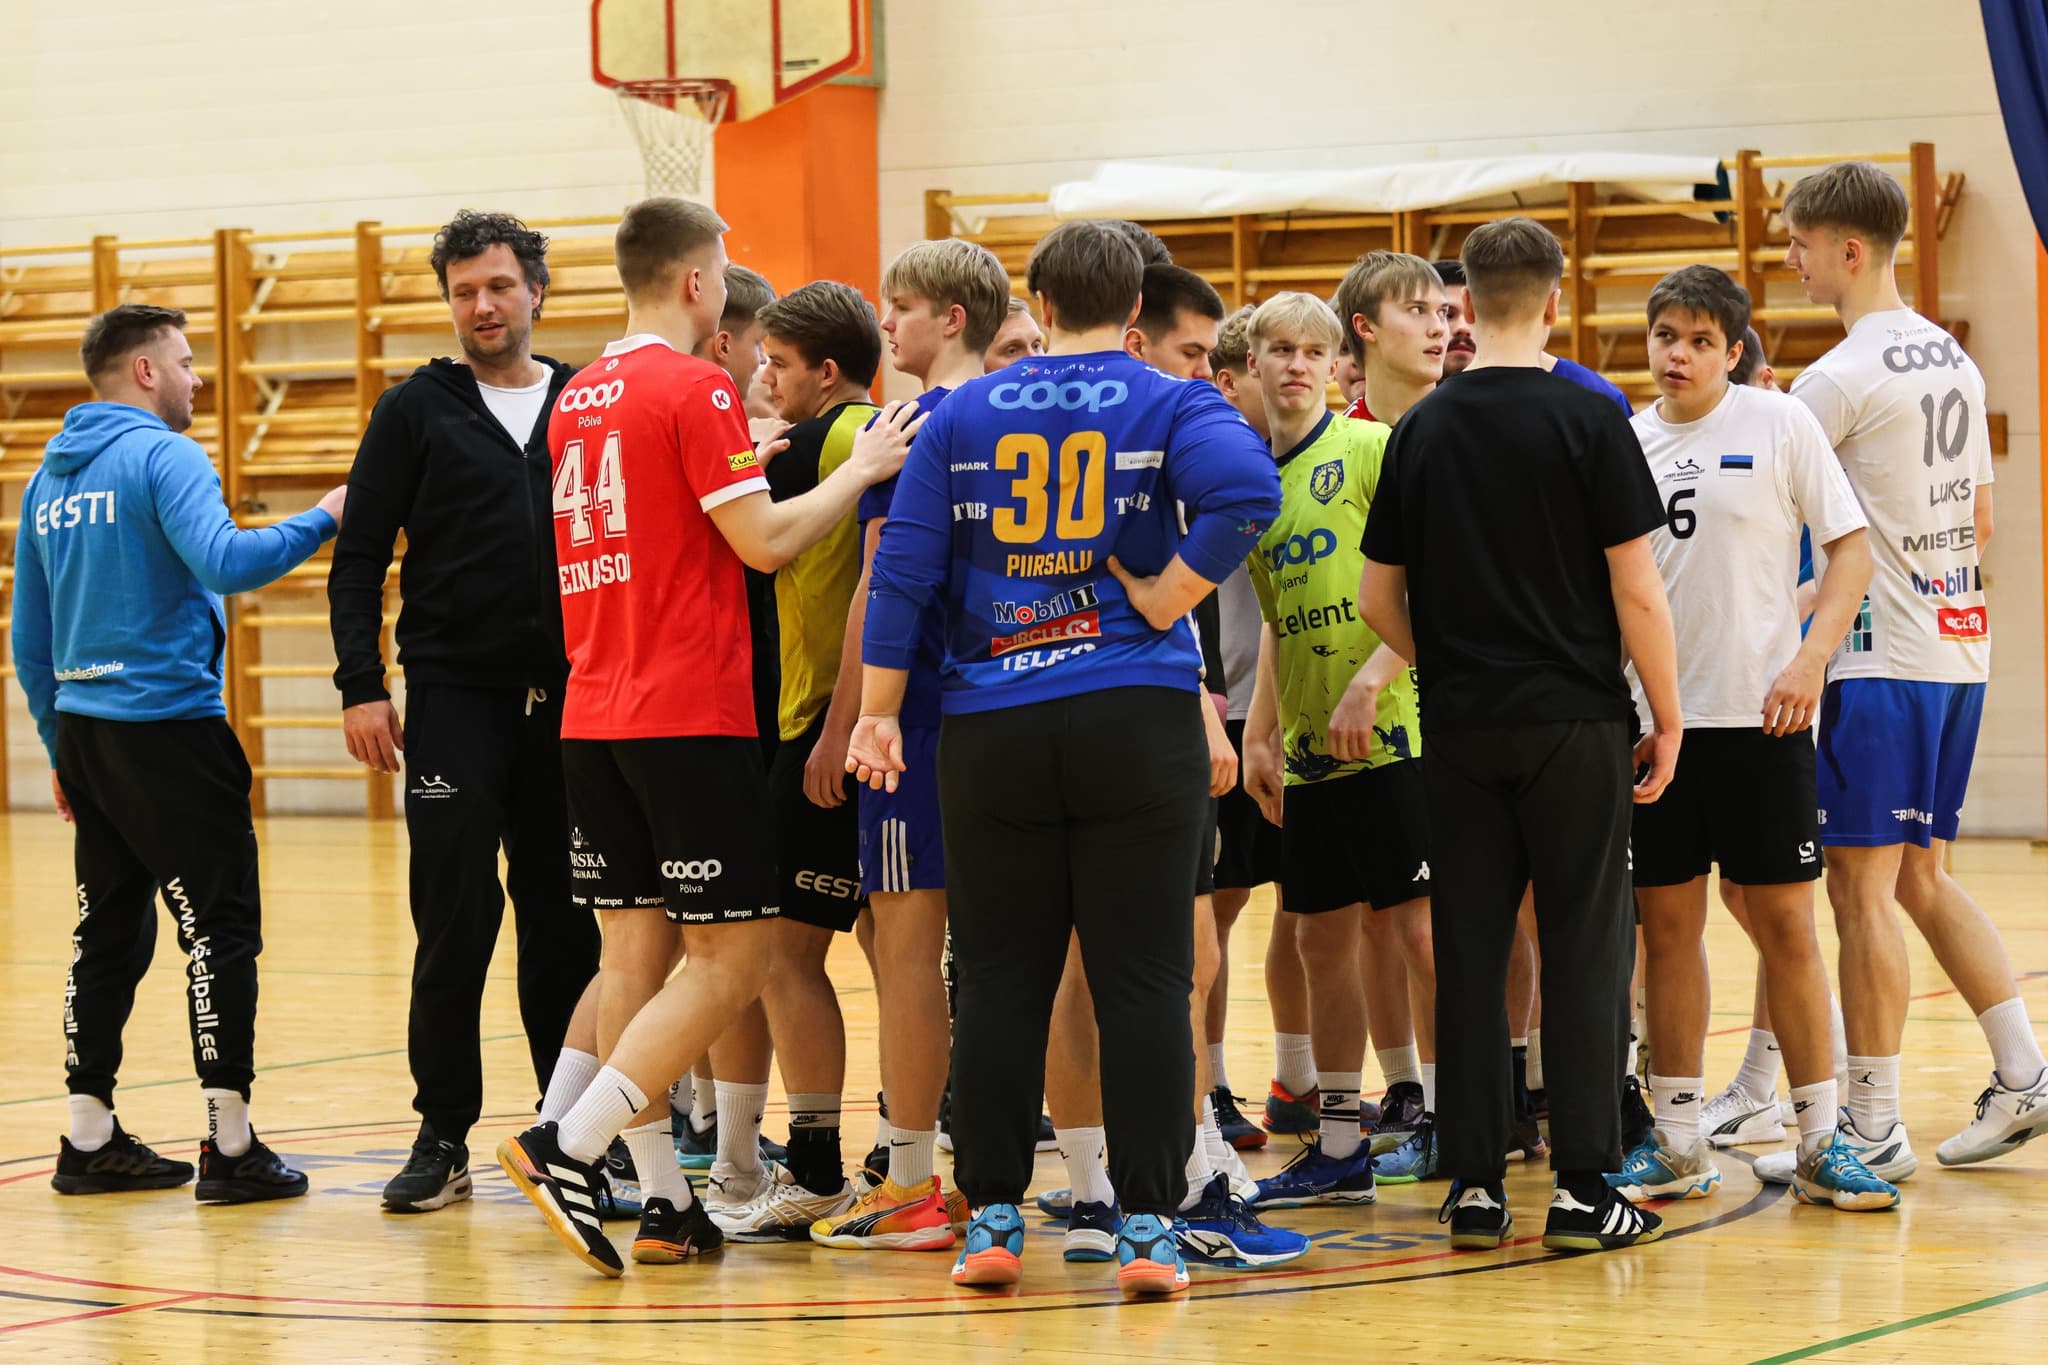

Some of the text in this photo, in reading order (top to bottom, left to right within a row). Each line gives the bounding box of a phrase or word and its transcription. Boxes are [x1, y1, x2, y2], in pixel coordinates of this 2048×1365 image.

[1883, 337, 1964, 373] coop
[560, 379, 625, 412] coop
[989, 380, 1128, 412] coop
[577, 414, 602, 429] Põlva
[1920, 387, 1969, 467] 10
[553, 430, 627, 548] 44
[992, 430, 1106, 544] 30
[1930, 478, 1971, 507] LUKS
[36, 491, 115, 535] EESTI
[1667, 488, 1696, 540] 6
[1006, 550, 1093, 577] PIIRSALU
[992, 593, 1068, 625] Mobil
[661, 859, 722, 881] coop
[594, 896, 623, 907] Kempa
[635, 896, 665, 905] Kempa
[679, 883, 704, 894] Põlva
[682, 911, 714, 922] Kempa
[724, 908, 753, 919] Kempa
